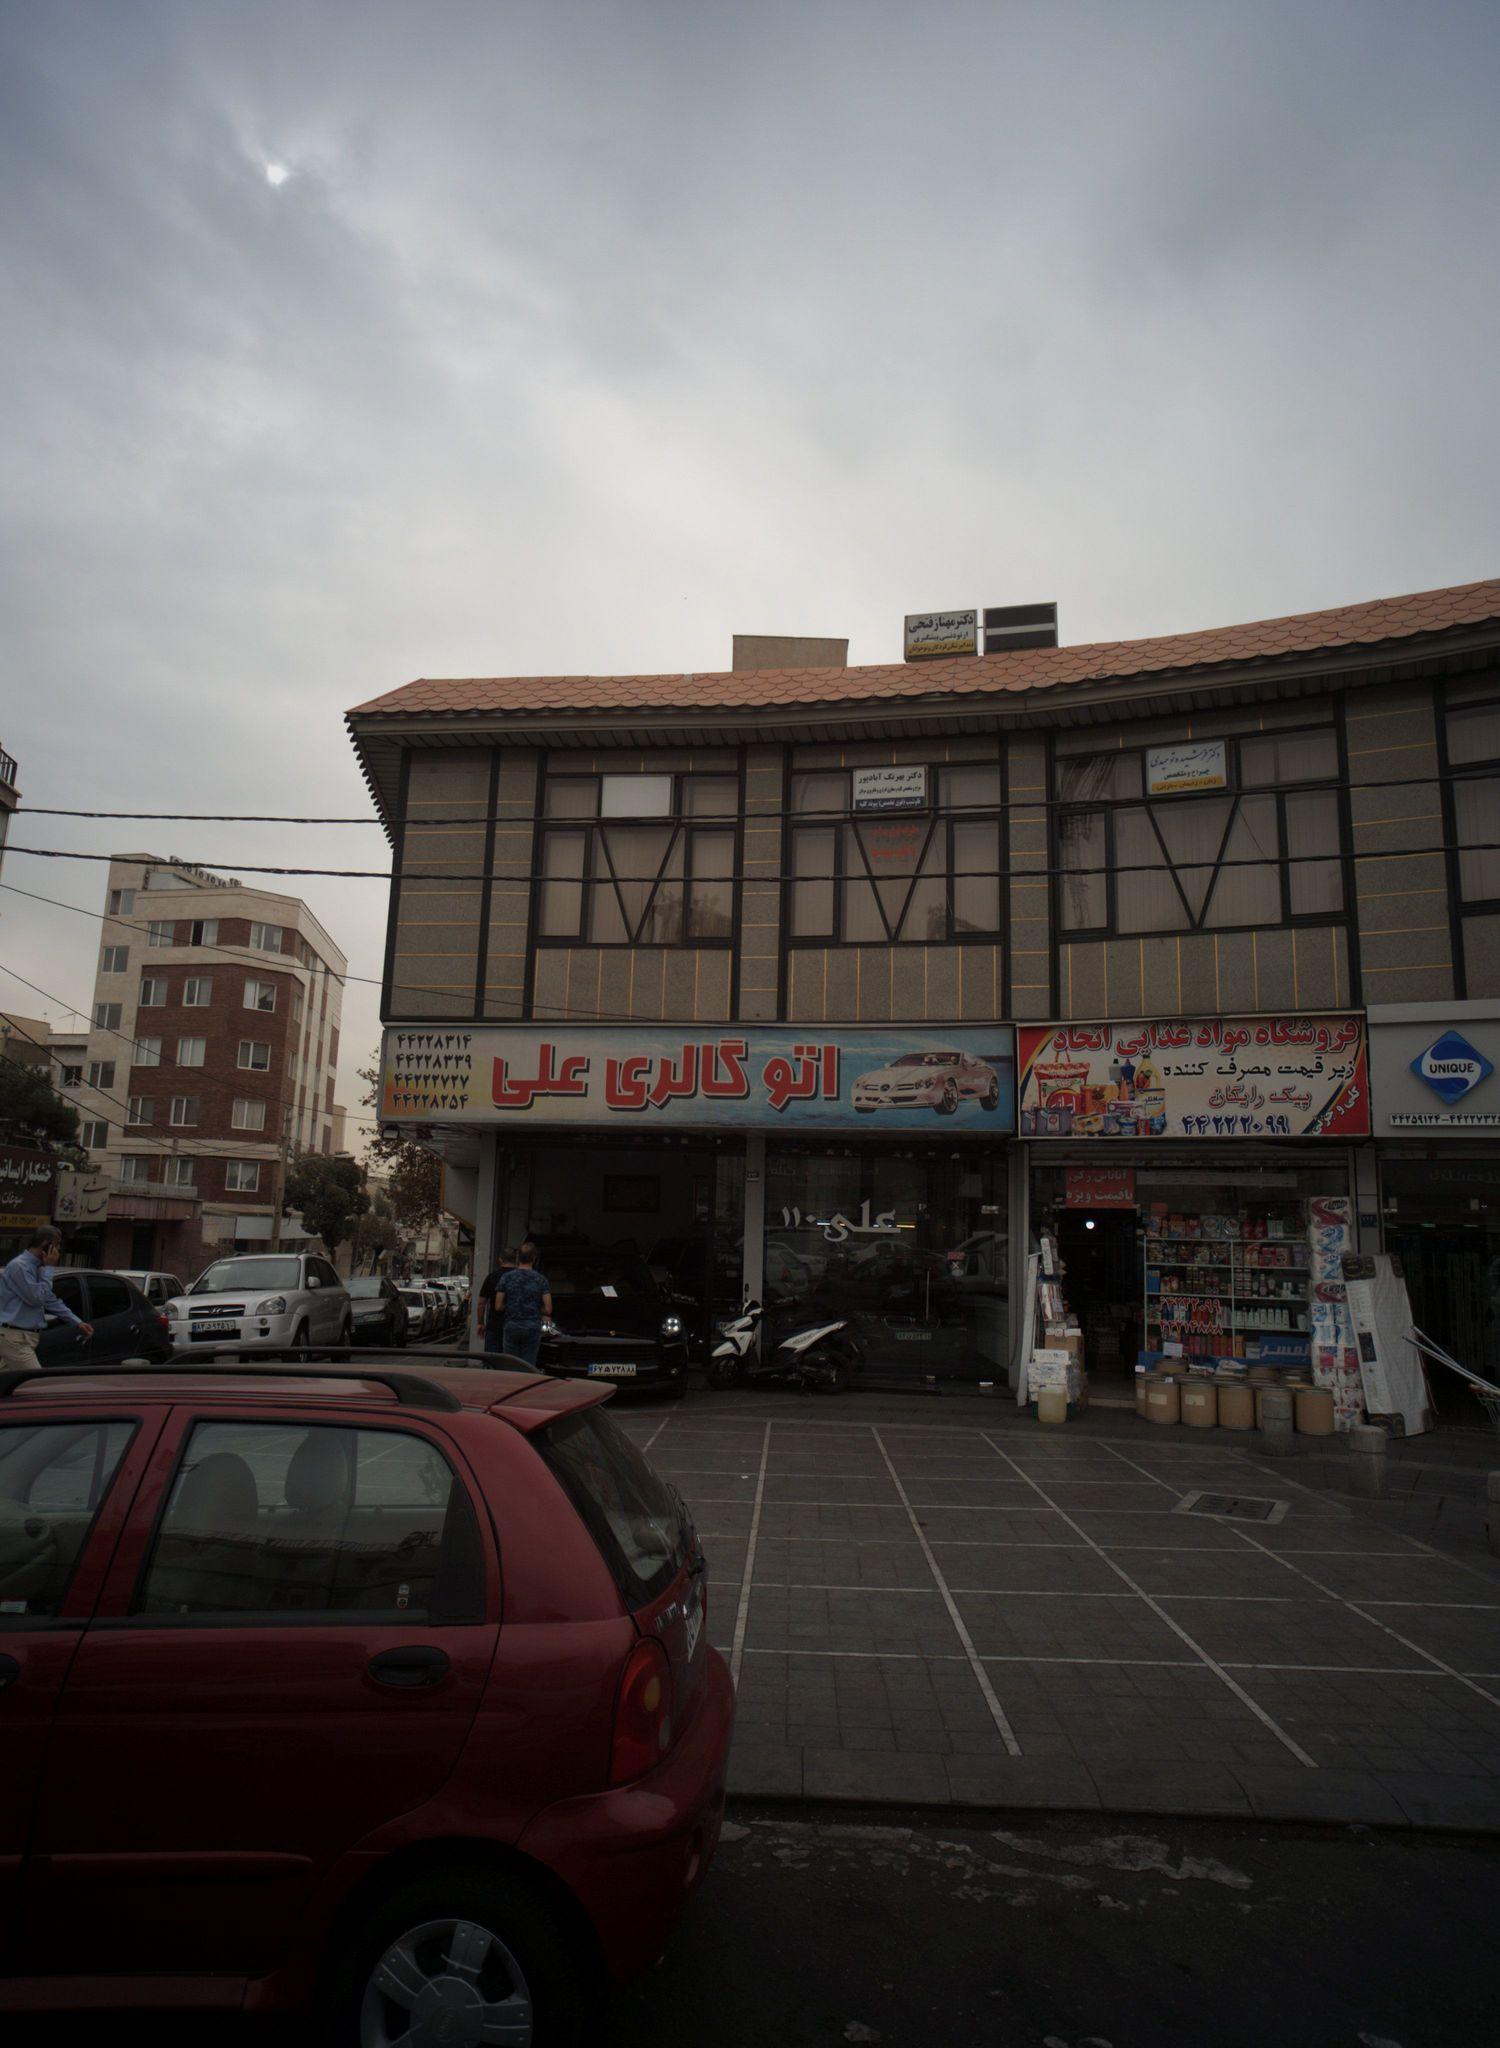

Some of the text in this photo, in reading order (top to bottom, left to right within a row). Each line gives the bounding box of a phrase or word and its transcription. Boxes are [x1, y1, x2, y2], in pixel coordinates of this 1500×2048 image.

[908, 615, 934, 633] فتحی
[954, 614, 974, 630] دکتر
[1207, 743, 1223, 762] دکتر
[907, 771, 922, 781] دکتر
[397, 1033, 472, 1050] ۴۴۲۲۸۳۱۴
[1052, 1016, 1360, 1058] فروشگاه مواد غذایی اتحاد
[395, 1053, 472, 1069] ۴۴۲۲۸۳۳۹
[1163, 1056, 1355, 1081] زیر قیمت مصرف کننده
[1429, 1062, 1475, 1074] UNIQUE
[491, 1039, 841, 1112] اتو گالری علی
[1208, 1083, 1313, 1111] پیک رایگان
[1344, 1085, 1360, 1109] کلی
[1336, 1104, 1345, 1116] و
[1181, 1114, 1290, 1134] ۴۴۲۲۲۰۹۹
[23, 1160, 52, 1187] خشکبار
[823, 1199, 901, 1242] علی
